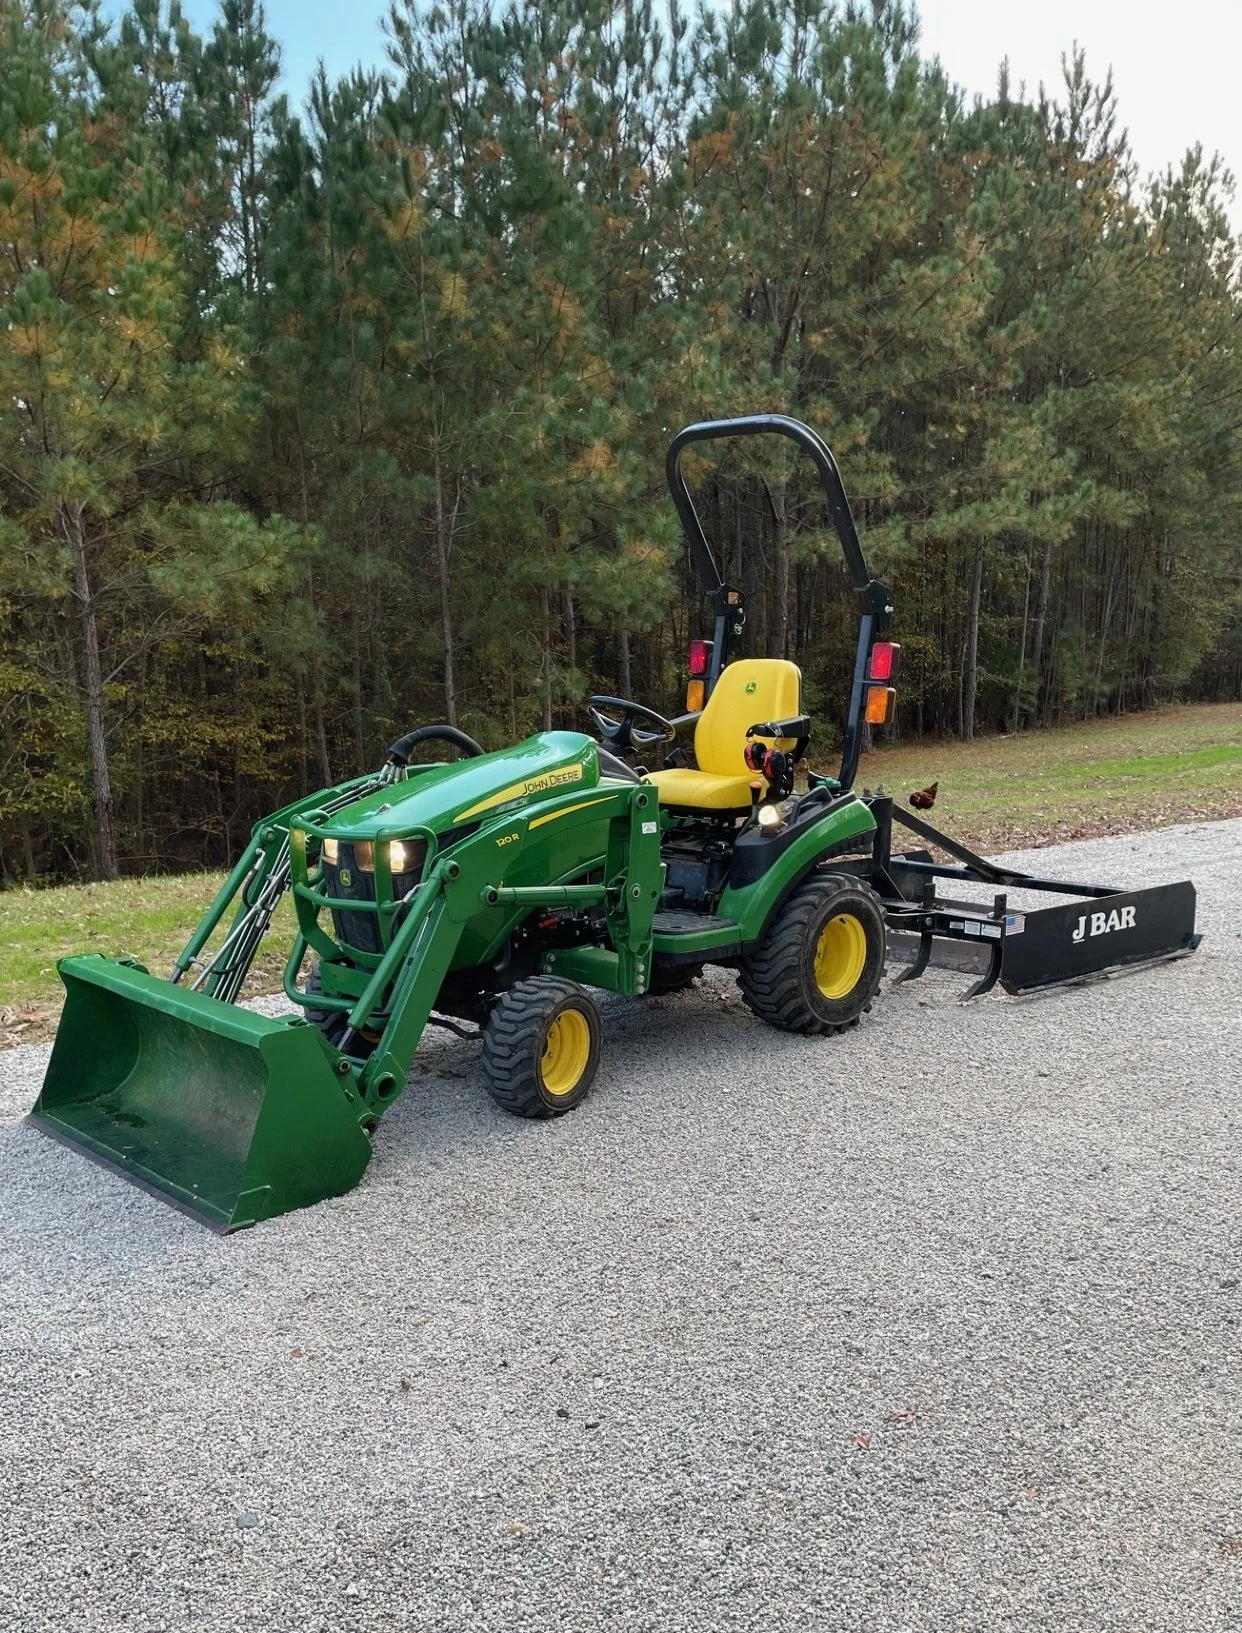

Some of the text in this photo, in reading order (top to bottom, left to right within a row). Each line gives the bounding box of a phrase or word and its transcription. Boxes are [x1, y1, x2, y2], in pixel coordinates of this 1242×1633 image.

[522, 770, 580, 795] JOHN DEERE
[1072, 905, 1137, 941] J BAR
